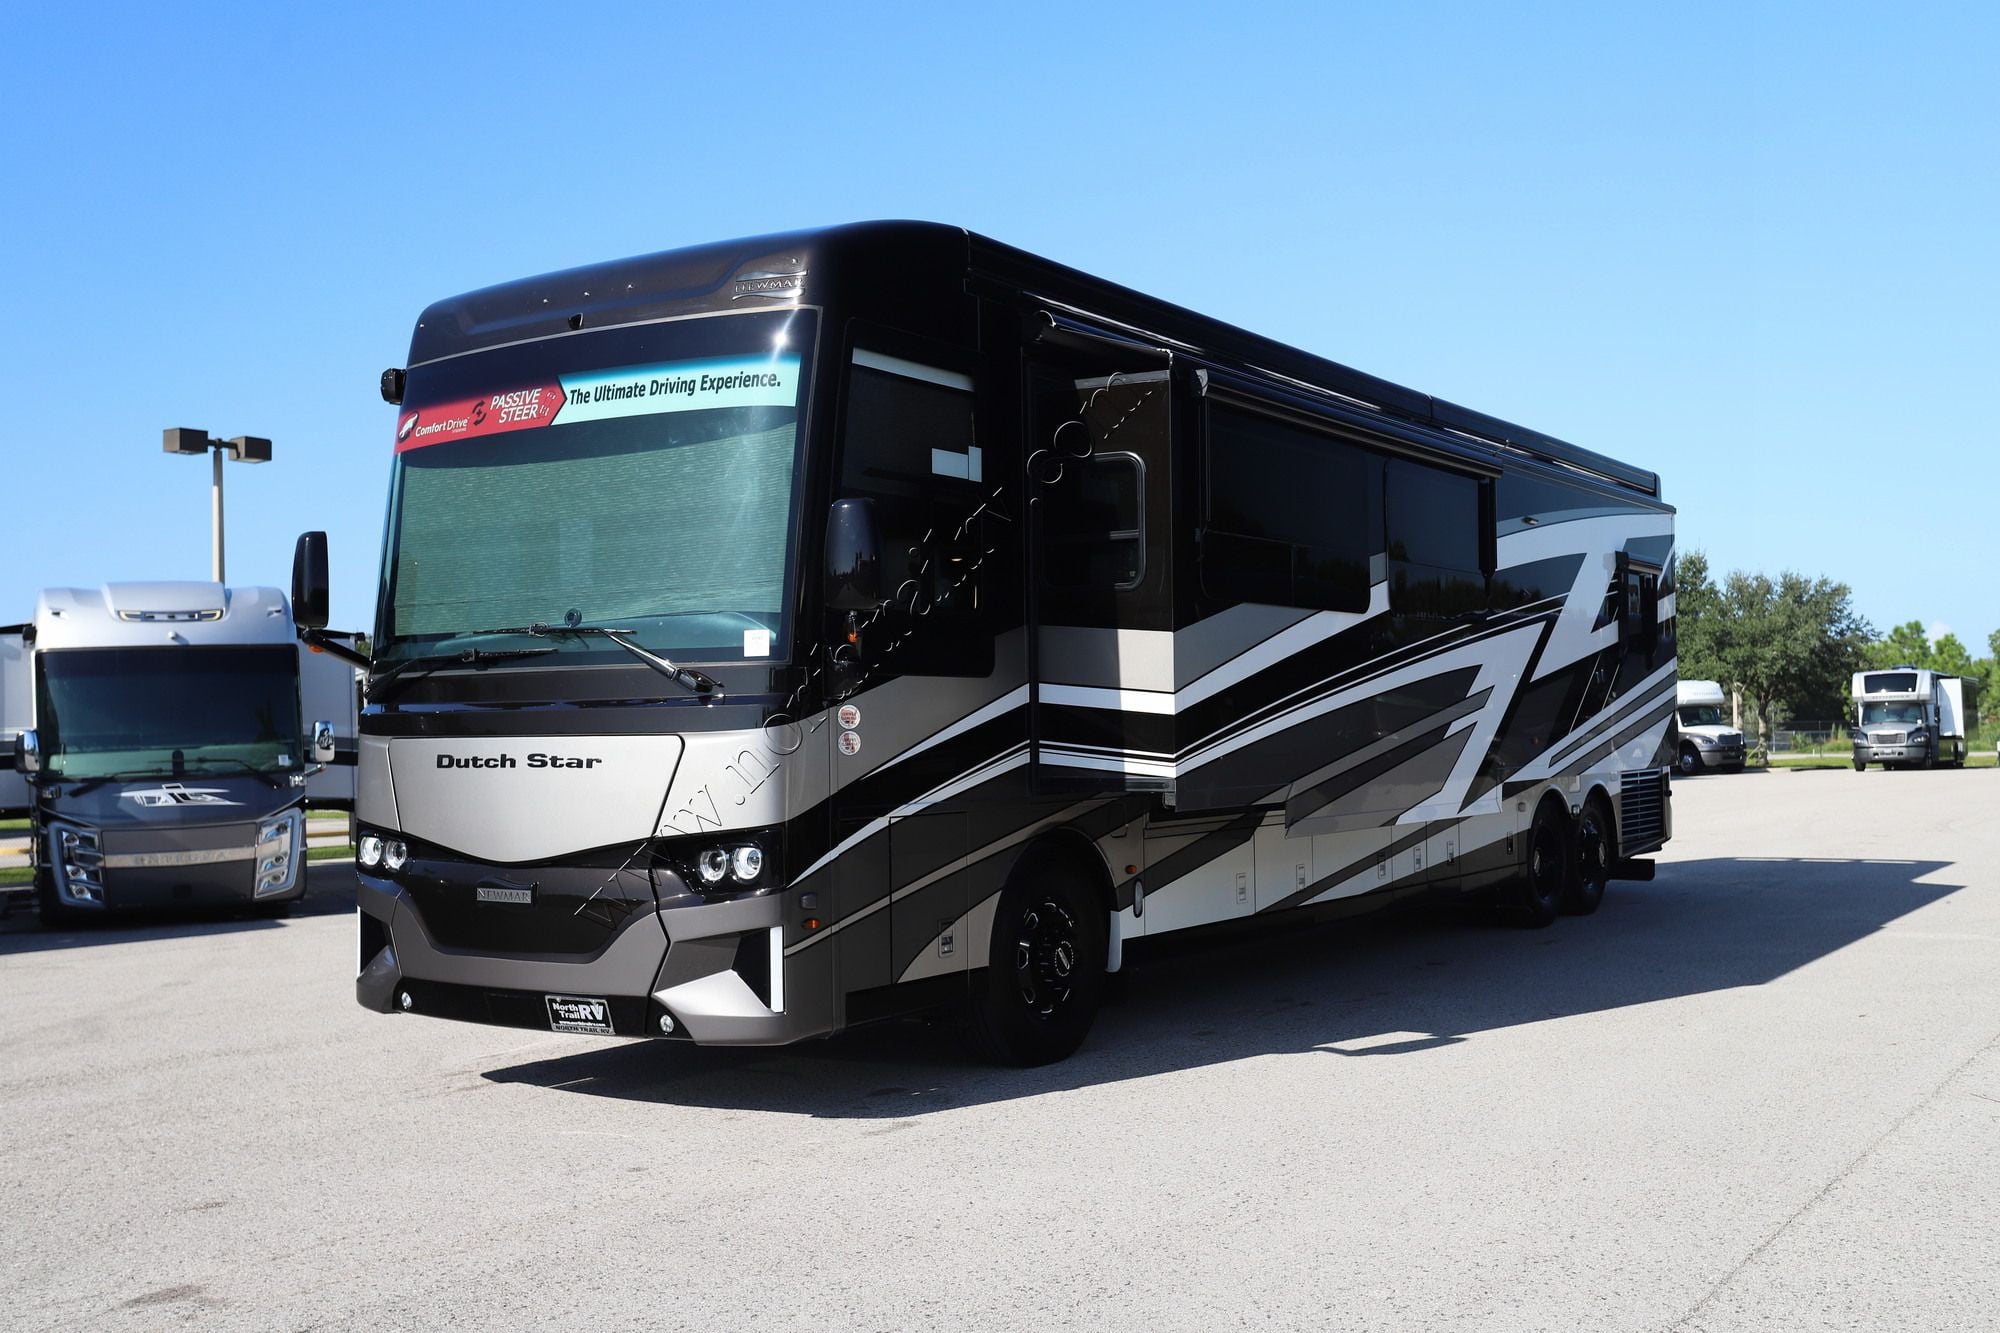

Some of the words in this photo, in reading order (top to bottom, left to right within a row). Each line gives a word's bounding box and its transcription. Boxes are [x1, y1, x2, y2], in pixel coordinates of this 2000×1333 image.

[570, 389, 591, 405] The
[594, 382, 646, 401] Ultimate
[649, 377, 696, 396] Driving
[700, 371, 781, 394] Experience.
[490, 388, 542, 410] PASSIVE
[499, 404, 538, 424] STEER
[415, 421, 447, 437] Comfort
[446, 417, 468, 431] Drive
[436, 754, 516, 769] Dutch
[527, 753, 602, 769] Star
[478, 889, 530, 902] NEWMAR
[552, 1002, 578, 1011] North
[559, 1010, 580, 1019] Trail
[578, 1004, 603, 1020] RV
